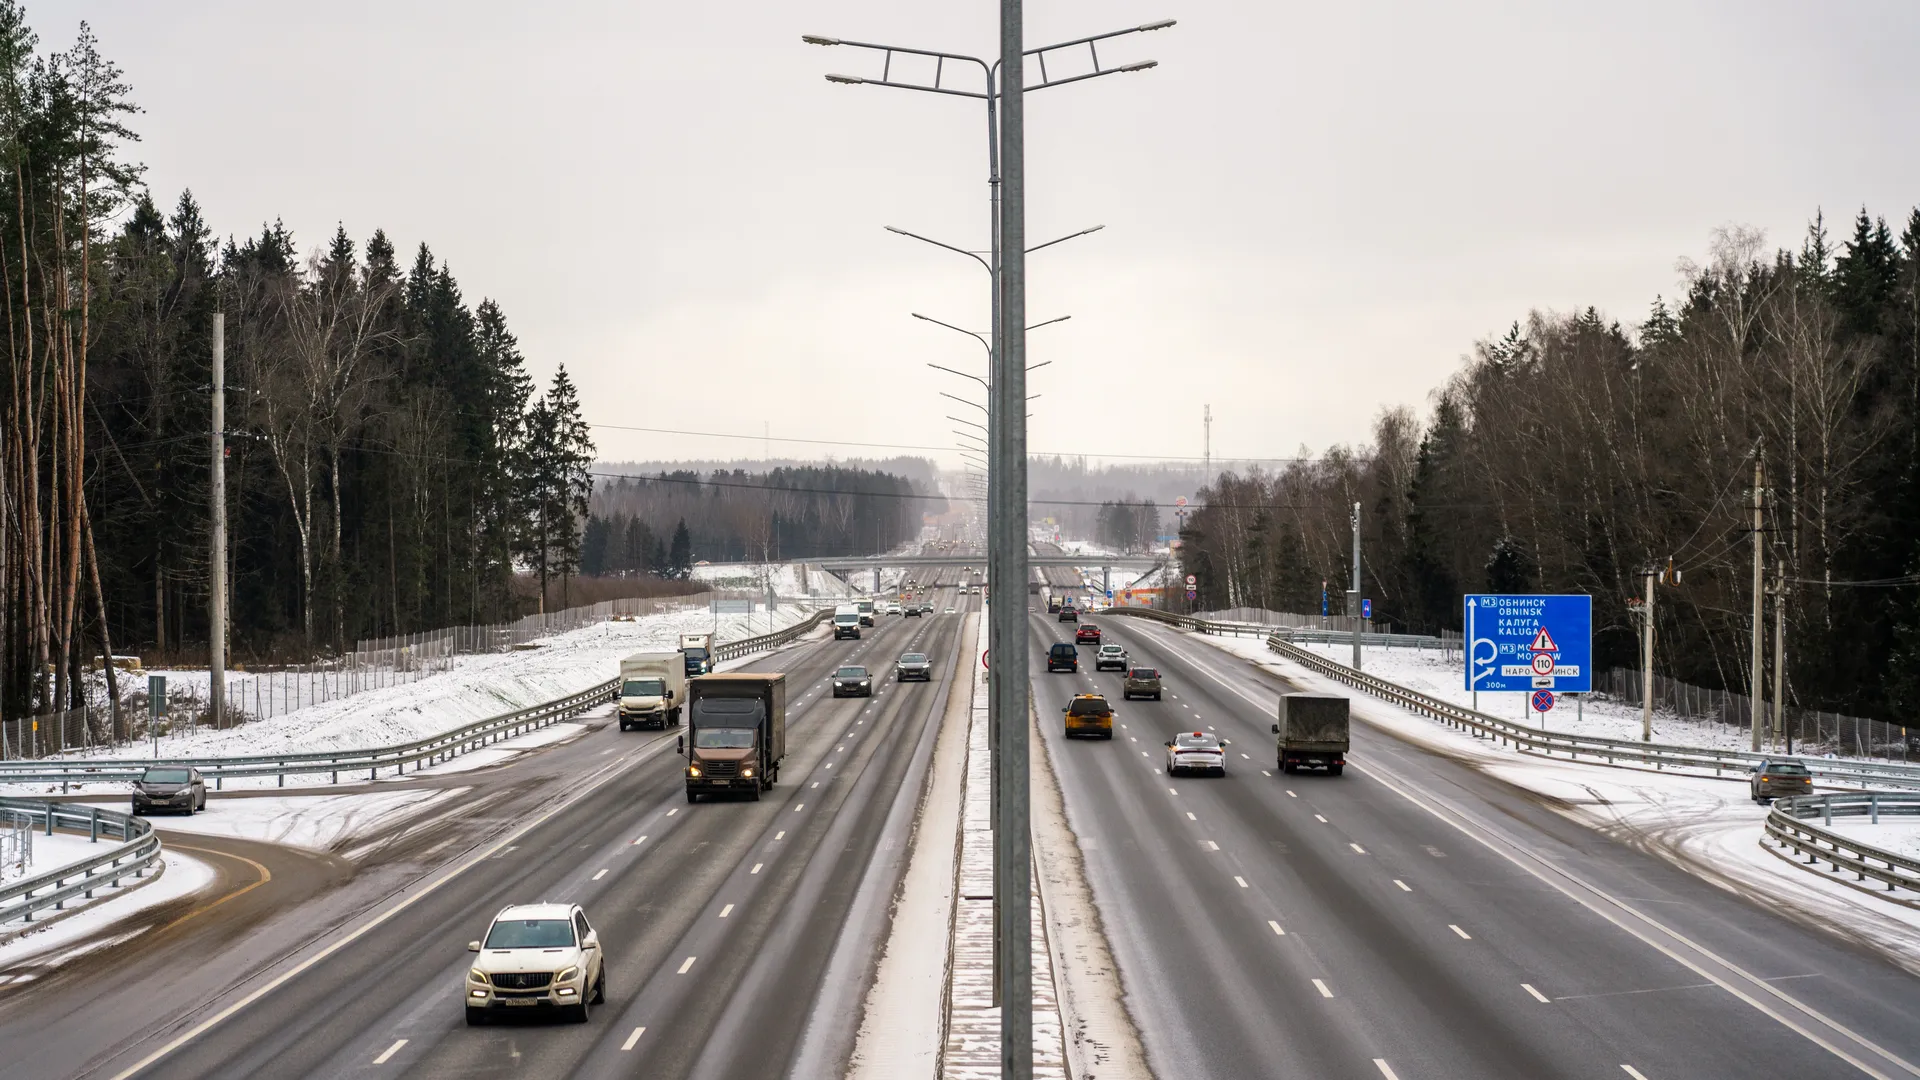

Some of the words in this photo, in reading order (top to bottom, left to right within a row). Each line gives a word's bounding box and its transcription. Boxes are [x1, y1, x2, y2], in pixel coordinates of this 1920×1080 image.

[1499, 599, 1546, 607] ОБНИНСК
[1499, 608, 1542, 616] OBNINSK
[1498, 619, 1539, 627] КАЛУГА
[1498, 628, 1539, 636] KALUGA
[1536, 660, 1551, 669] 110
